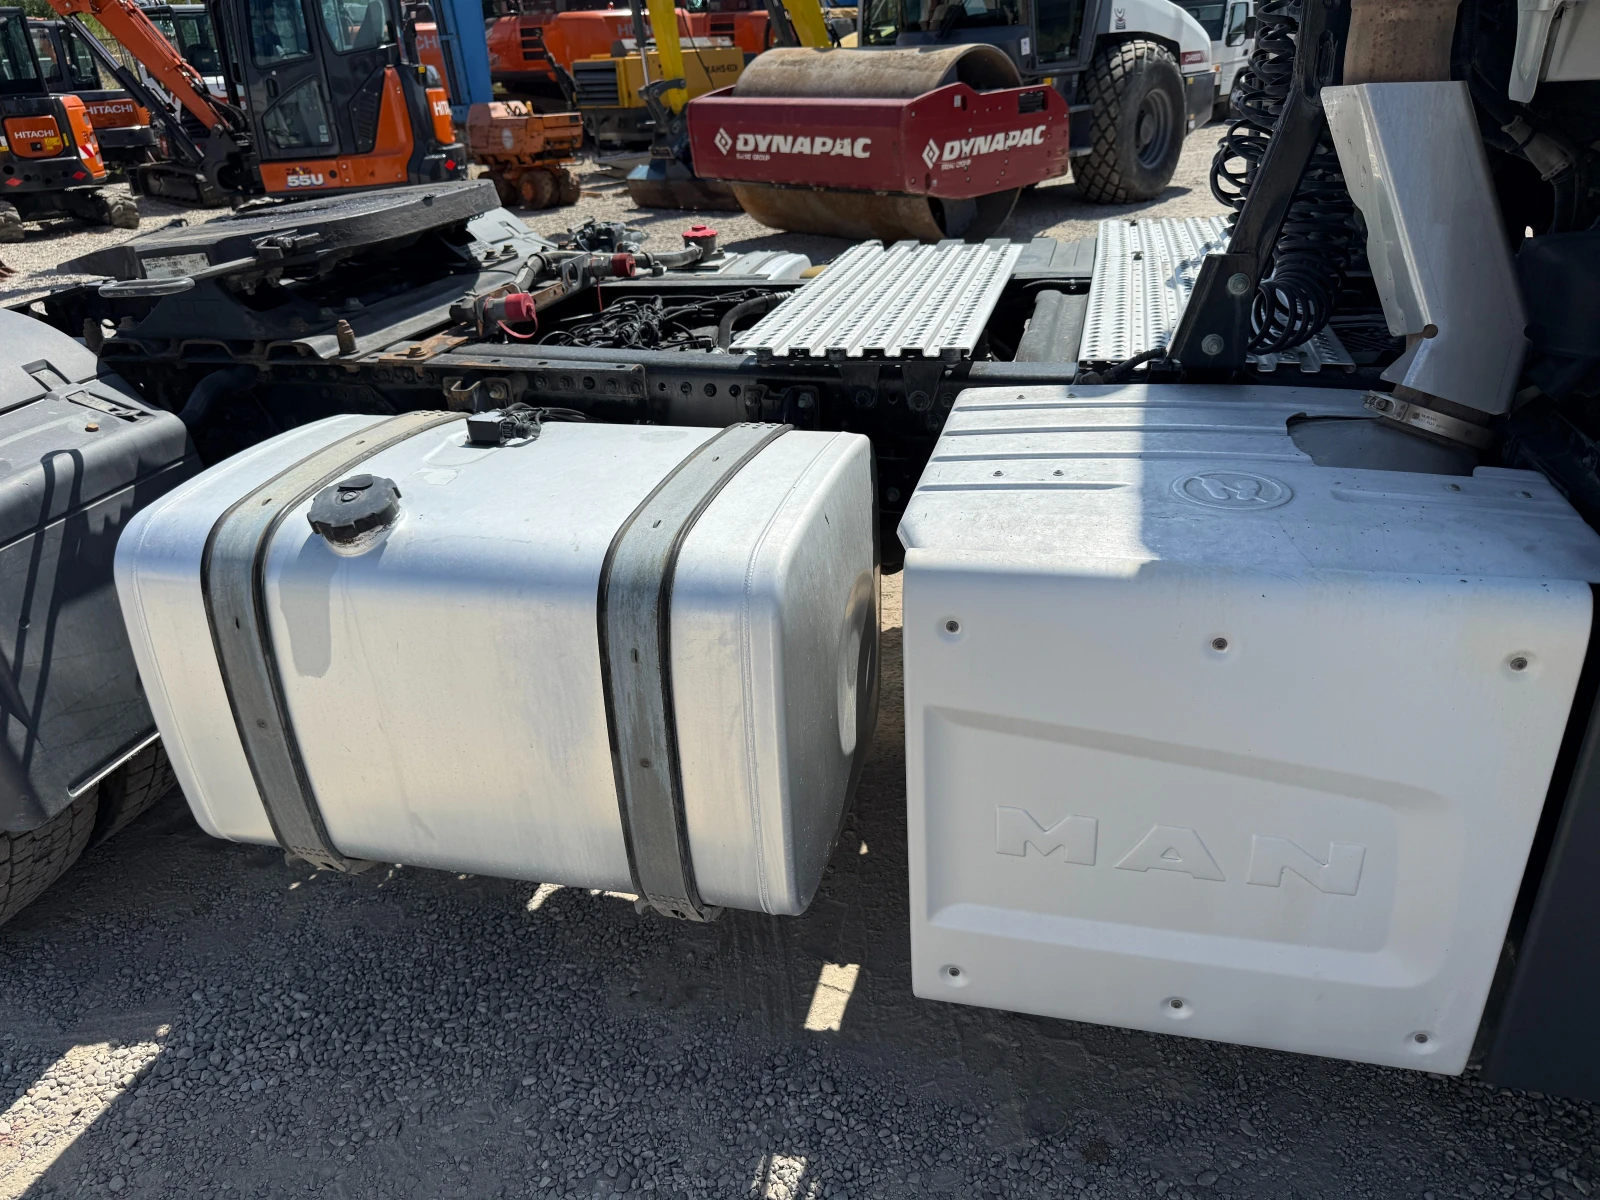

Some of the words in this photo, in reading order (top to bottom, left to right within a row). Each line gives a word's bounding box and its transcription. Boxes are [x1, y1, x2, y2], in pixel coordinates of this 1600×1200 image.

[14, 129, 54, 139] HITACHI
[736, 134, 871, 158] DYNAPAC
[942, 125, 1046, 161] DYNAPAC
[287, 173, 324, 187] 55U
[996, 805, 1366, 896] MAN
